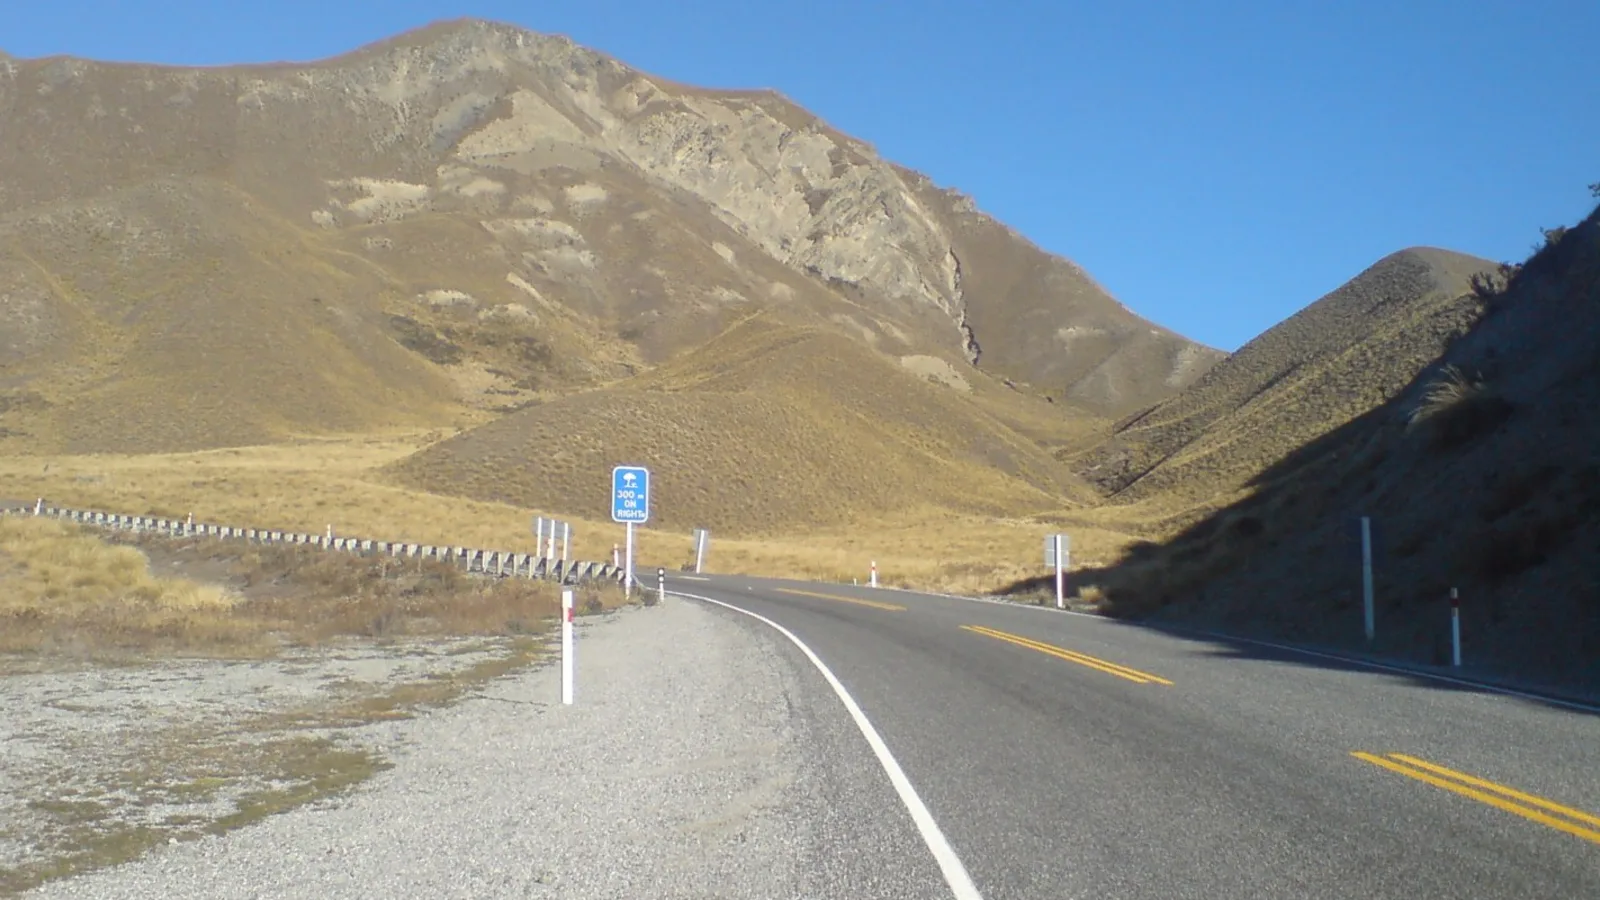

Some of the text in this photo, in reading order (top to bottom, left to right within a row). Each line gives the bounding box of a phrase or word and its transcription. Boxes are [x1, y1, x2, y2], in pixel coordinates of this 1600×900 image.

[617, 490, 635, 499] 300
[624, 500, 637, 508] ON
[617, 509, 642, 518] RIGHT
